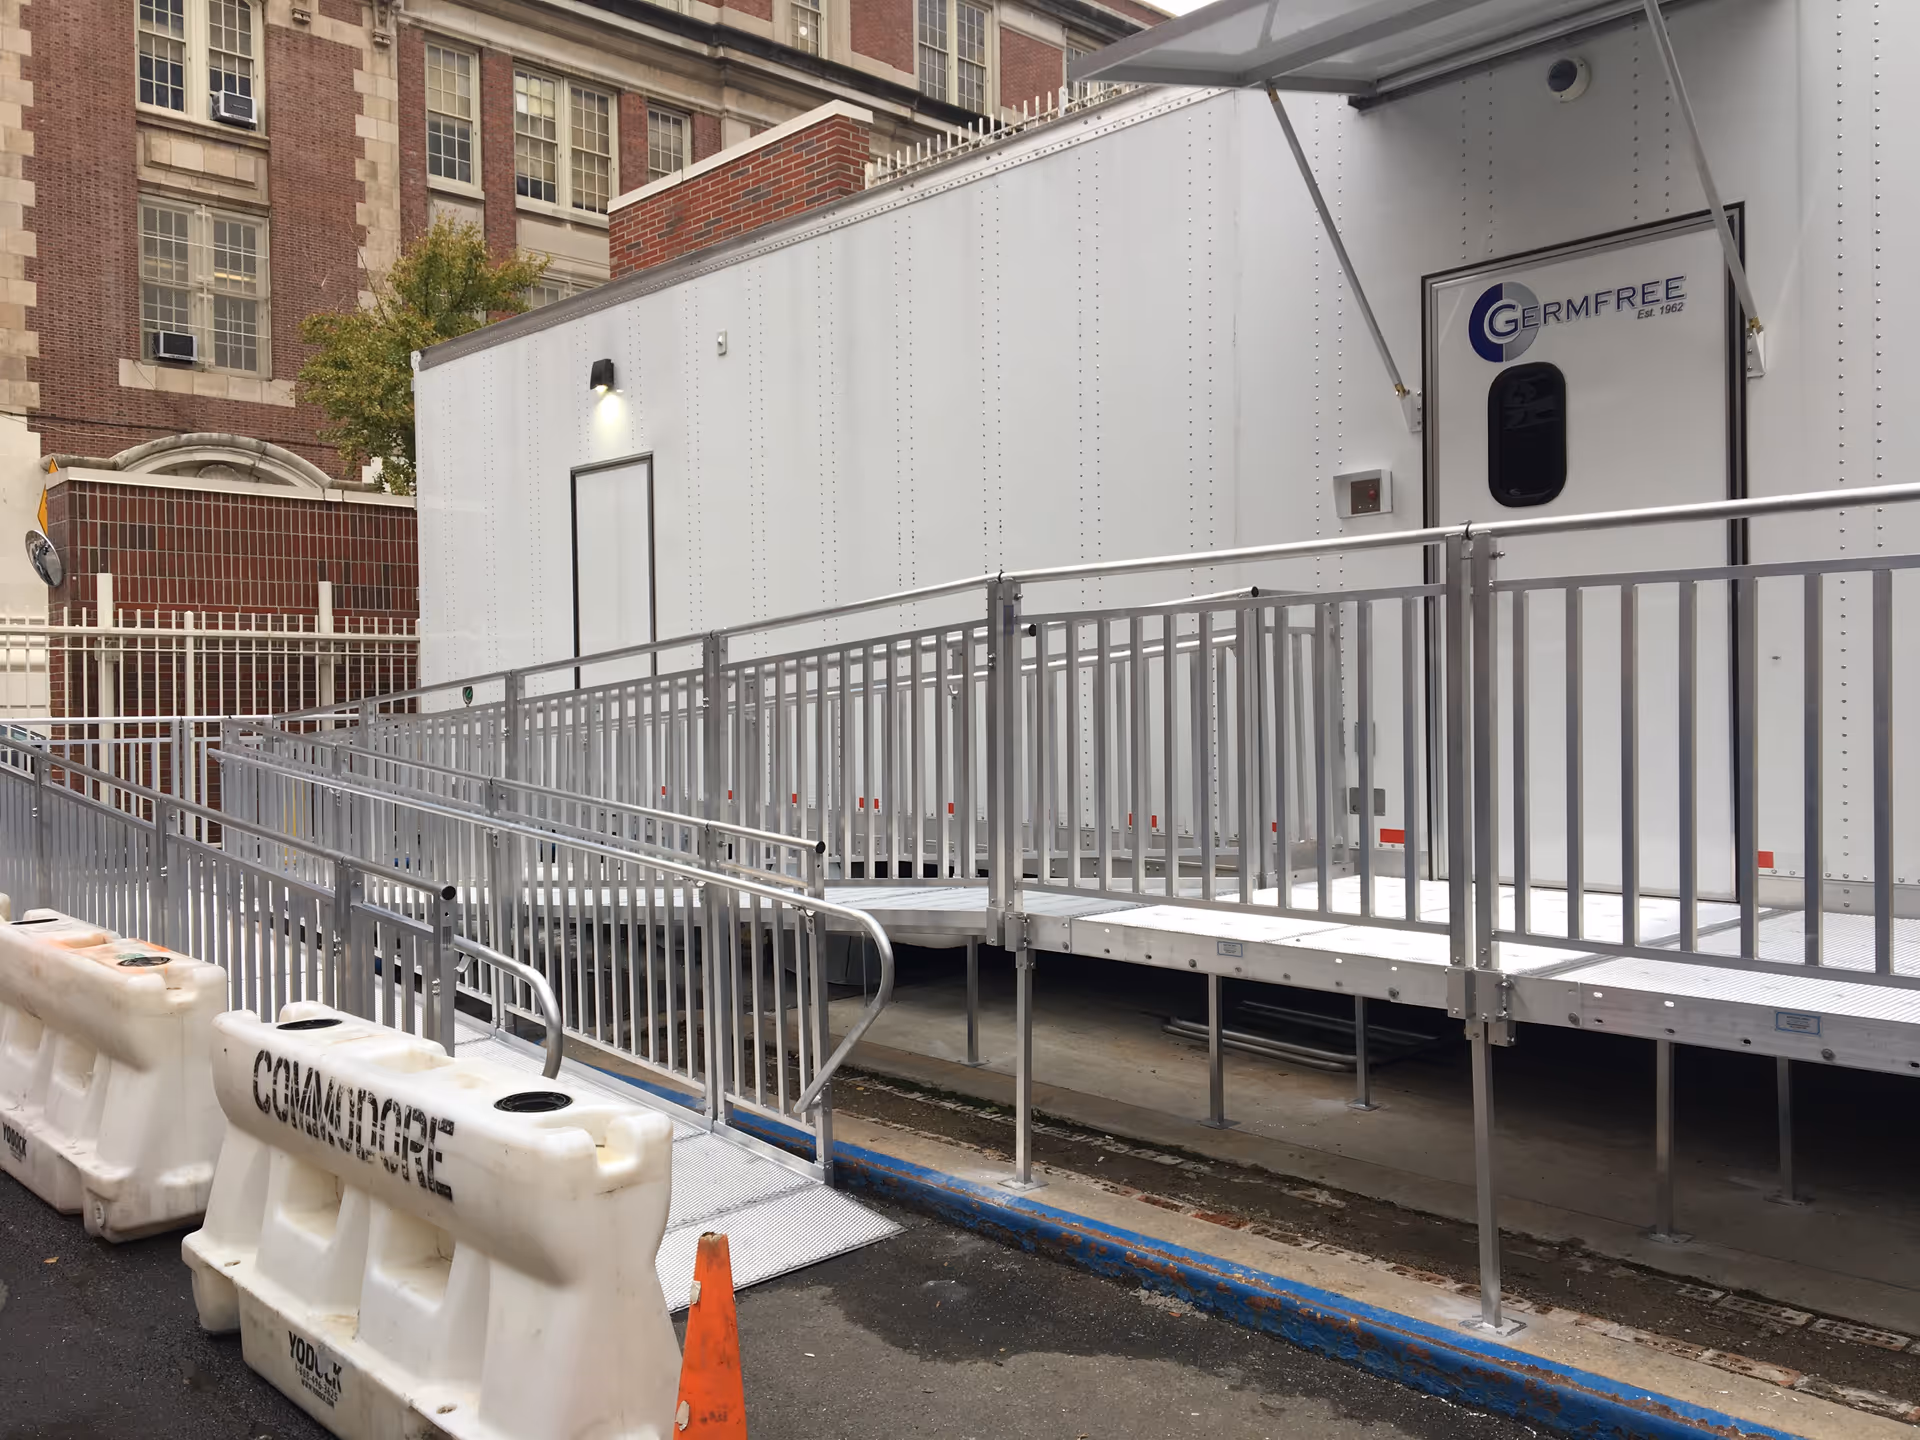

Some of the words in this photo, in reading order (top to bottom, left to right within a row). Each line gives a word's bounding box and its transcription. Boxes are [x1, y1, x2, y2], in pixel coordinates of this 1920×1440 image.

[1488, 275, 1687, 338] GERMFREE
[1637, 307, 1656, 320] Est.
[1659, 302, 1684, 315] 1962
[253, 1049, 455, 1203] COMMODORE
